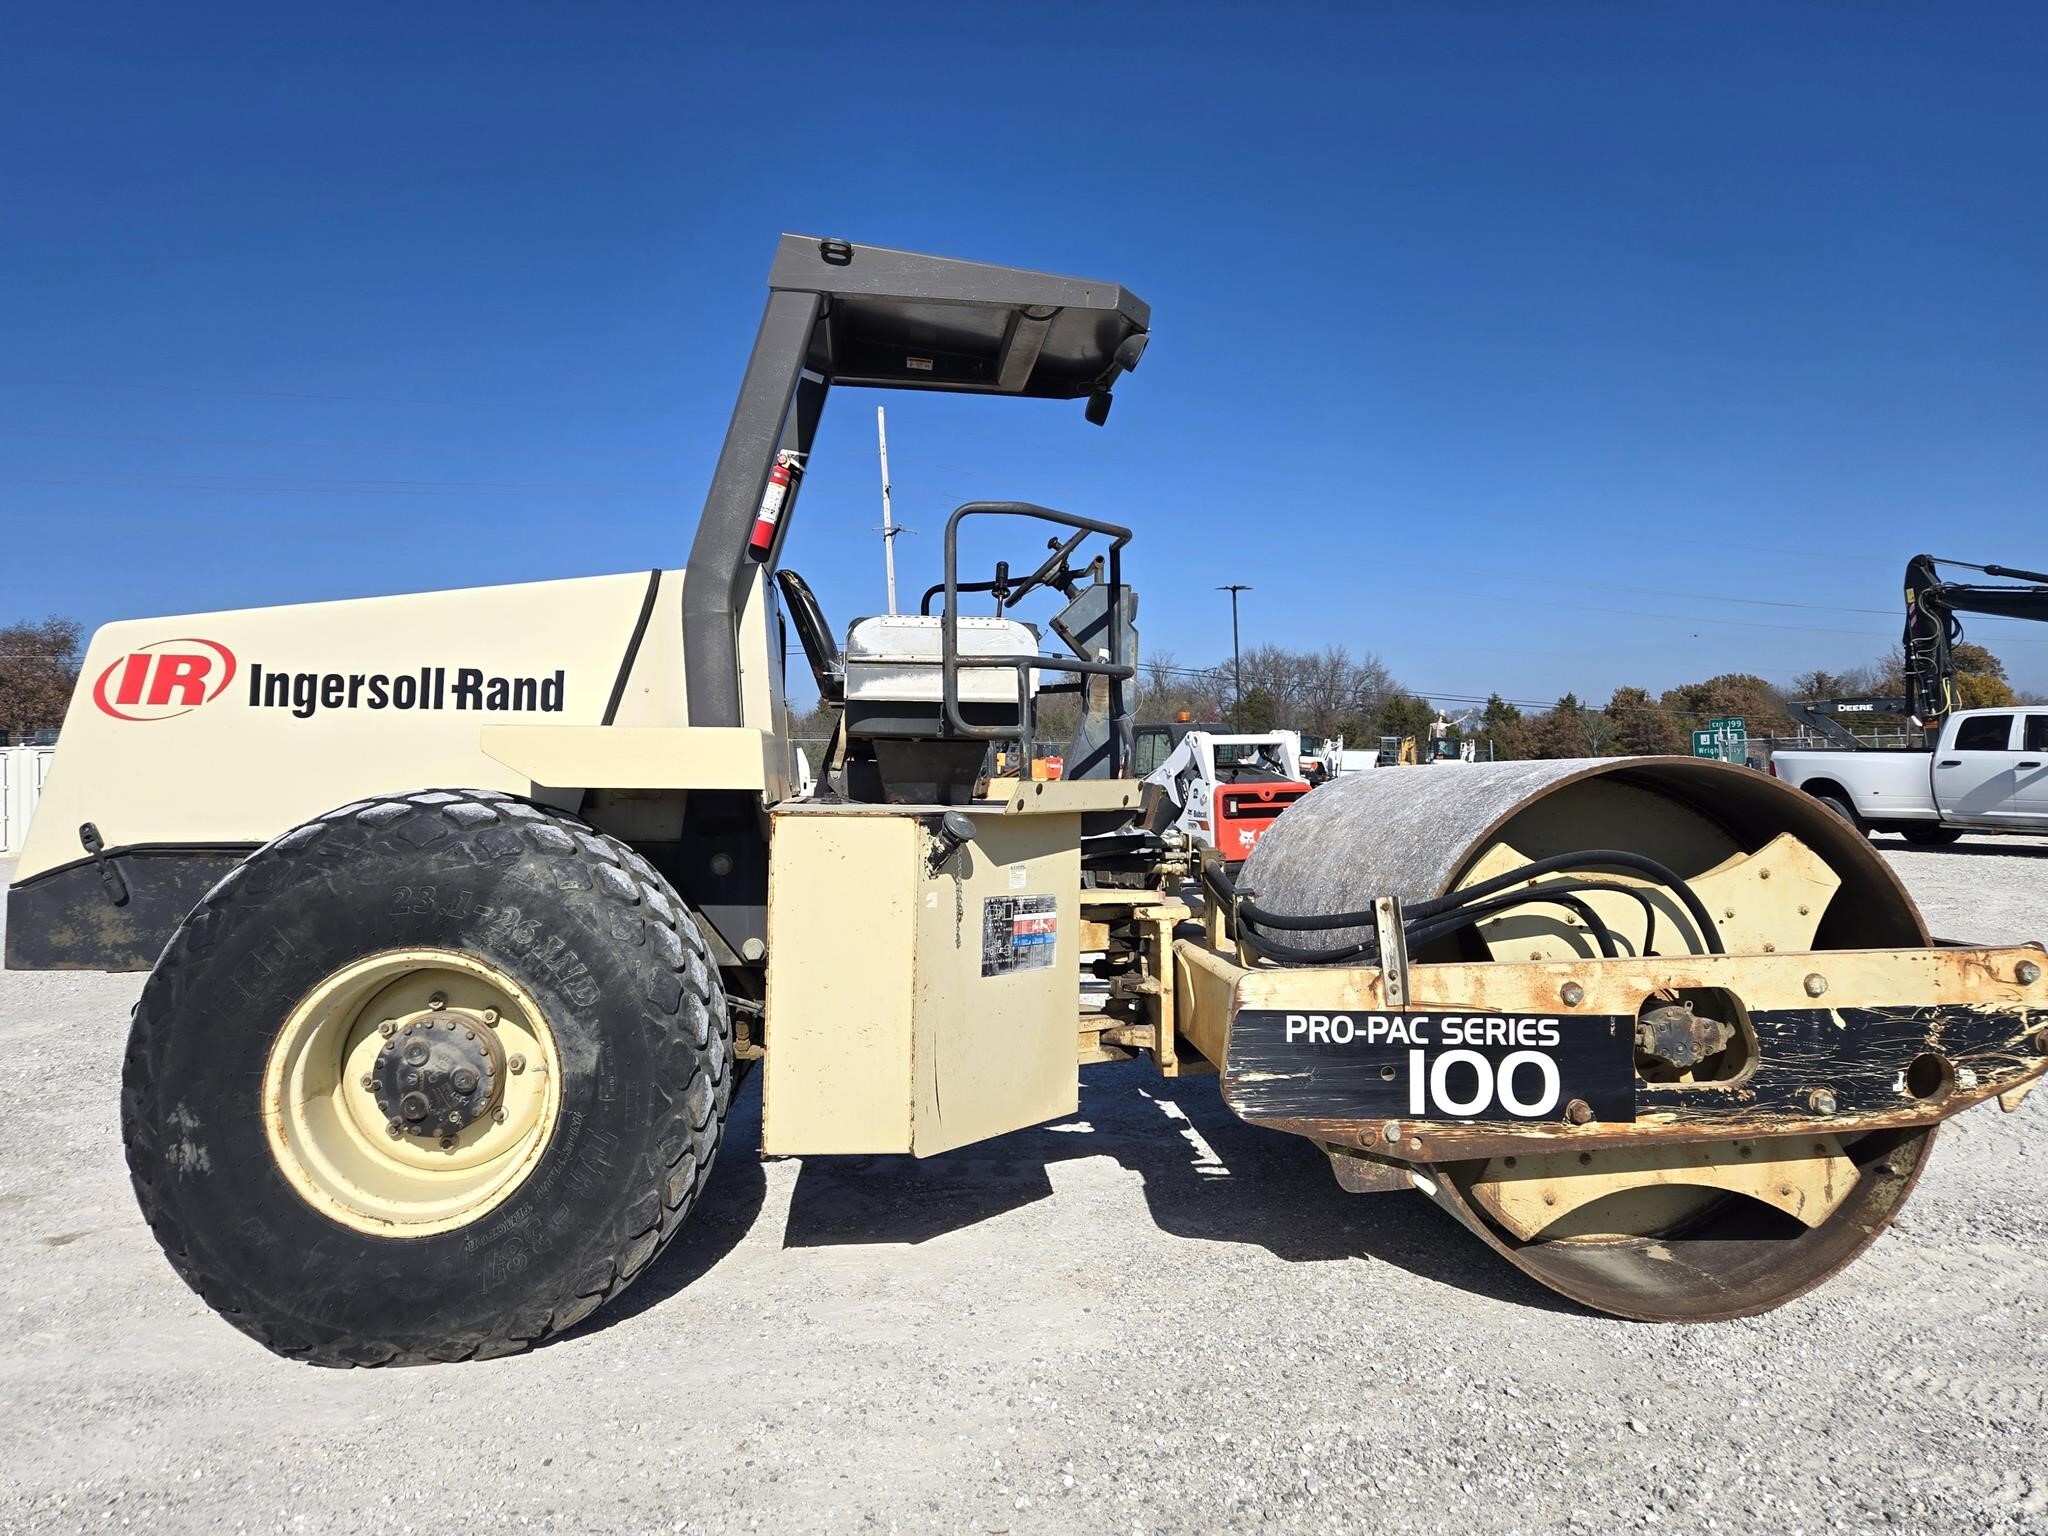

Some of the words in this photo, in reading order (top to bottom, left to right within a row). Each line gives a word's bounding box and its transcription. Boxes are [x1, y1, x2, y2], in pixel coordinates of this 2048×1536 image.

[115, 653, 212, 706] IR
[249, 663, 565, 718] Ingersoll-Rand
[1727, 720, 1742, 728] 199
[1837, 704, 1874, 712] DEERE
[1697, 746, 1722, 756] Wrigh
[1285, 1015, 1429, 1044] PRO-PAC
[1441, 1017, 1560, 1047] SERIES
[1409, 1049, 1561, 1117] 100
